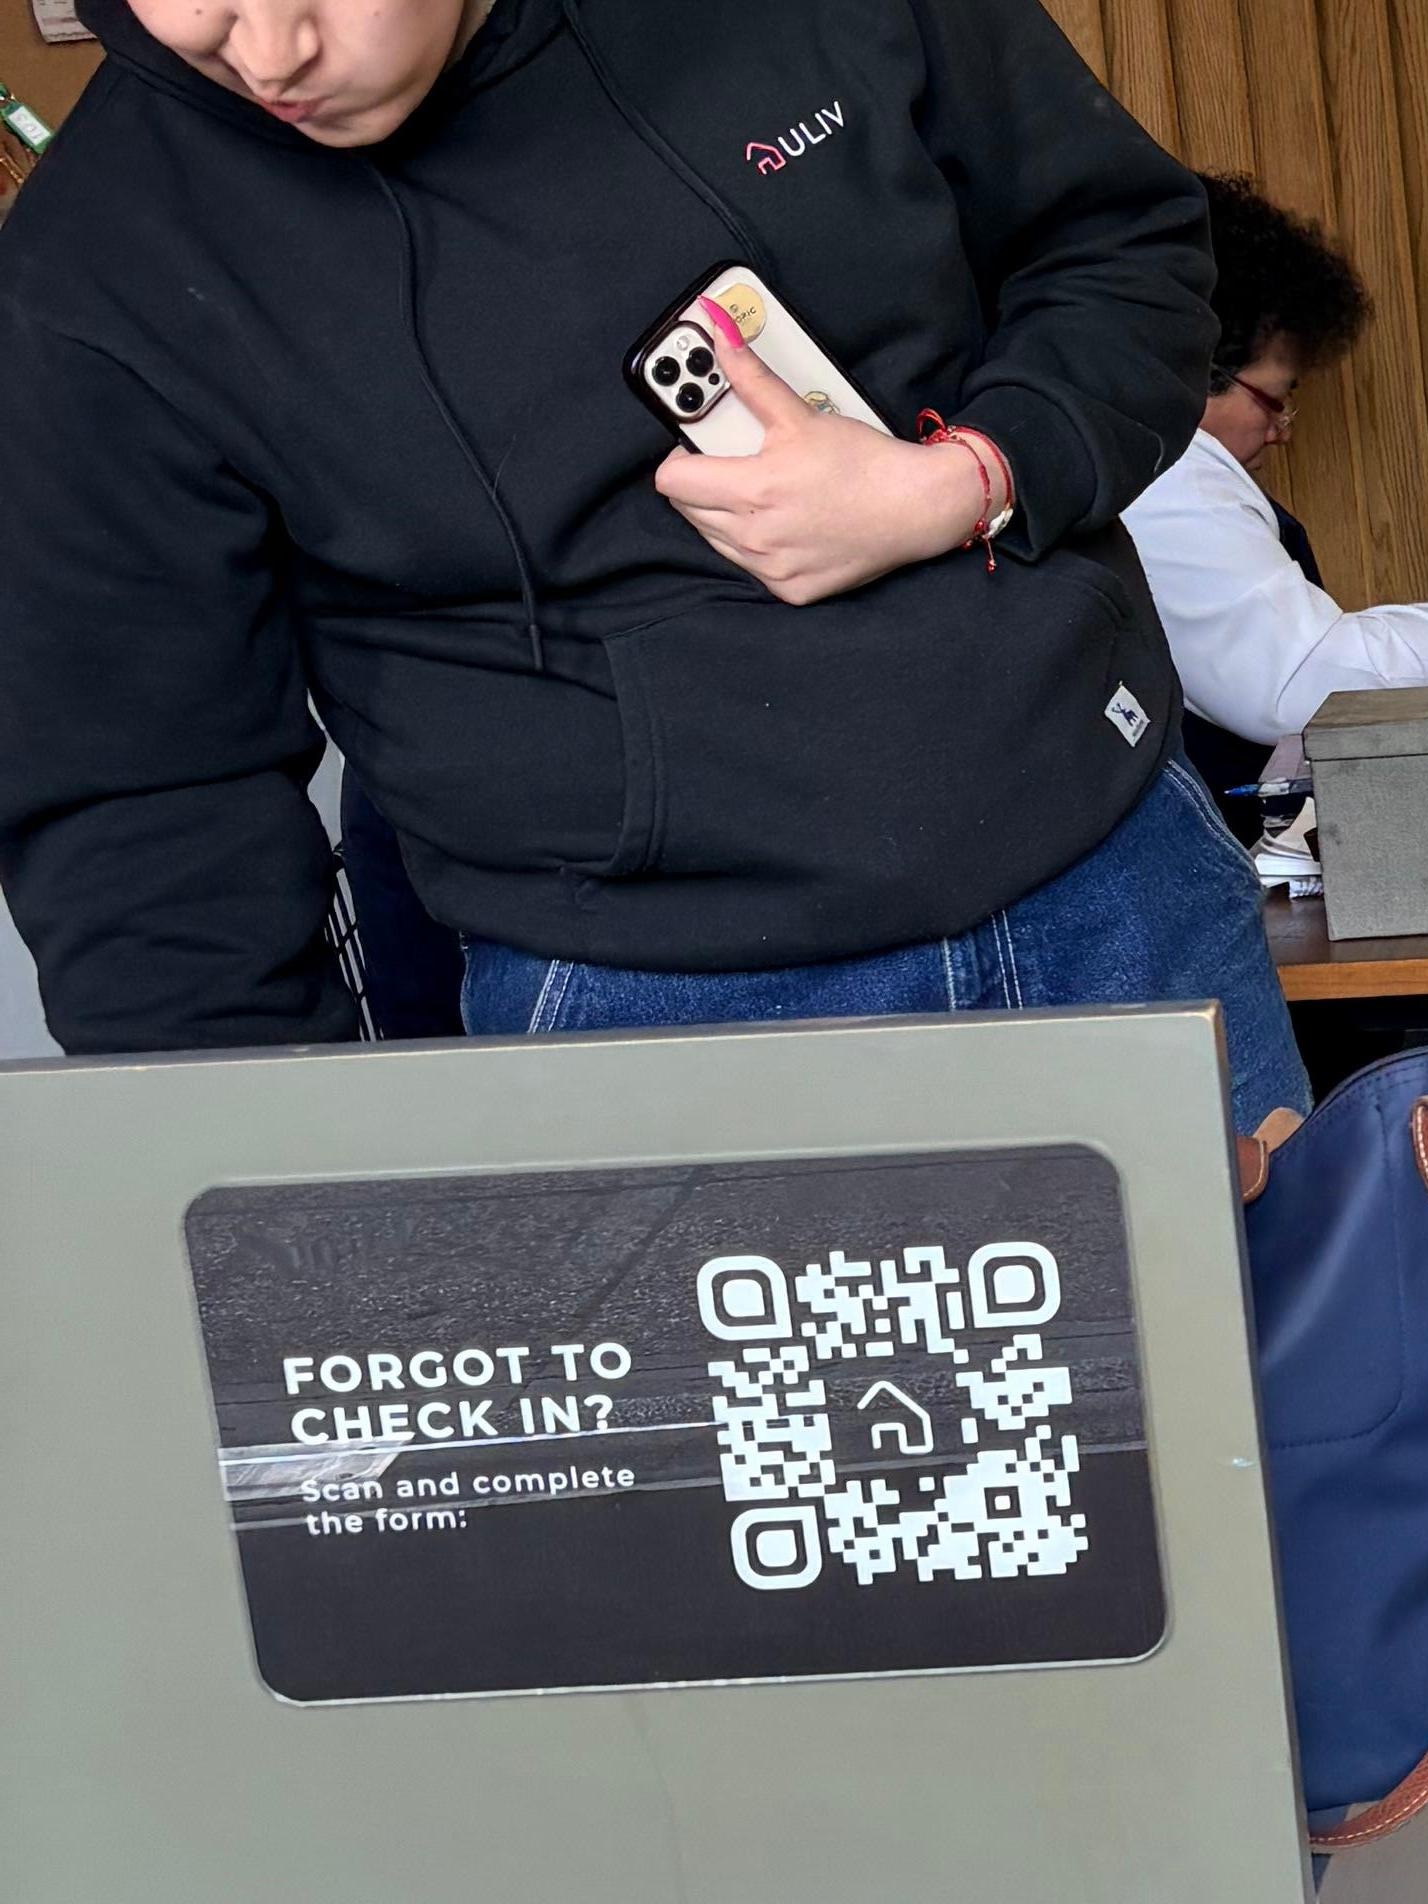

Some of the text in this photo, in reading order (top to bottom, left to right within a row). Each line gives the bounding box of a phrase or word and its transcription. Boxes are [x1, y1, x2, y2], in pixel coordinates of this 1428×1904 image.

[777, 100, 844, 156] ULIV
[283, 1342, 632, 1395] FORGOT TO
[290, 1394, 614, 1446] CHECK IN?
[302, 1466, 635, 1502] Scan and complete
[306, 1507, 467, 1535] the form:
